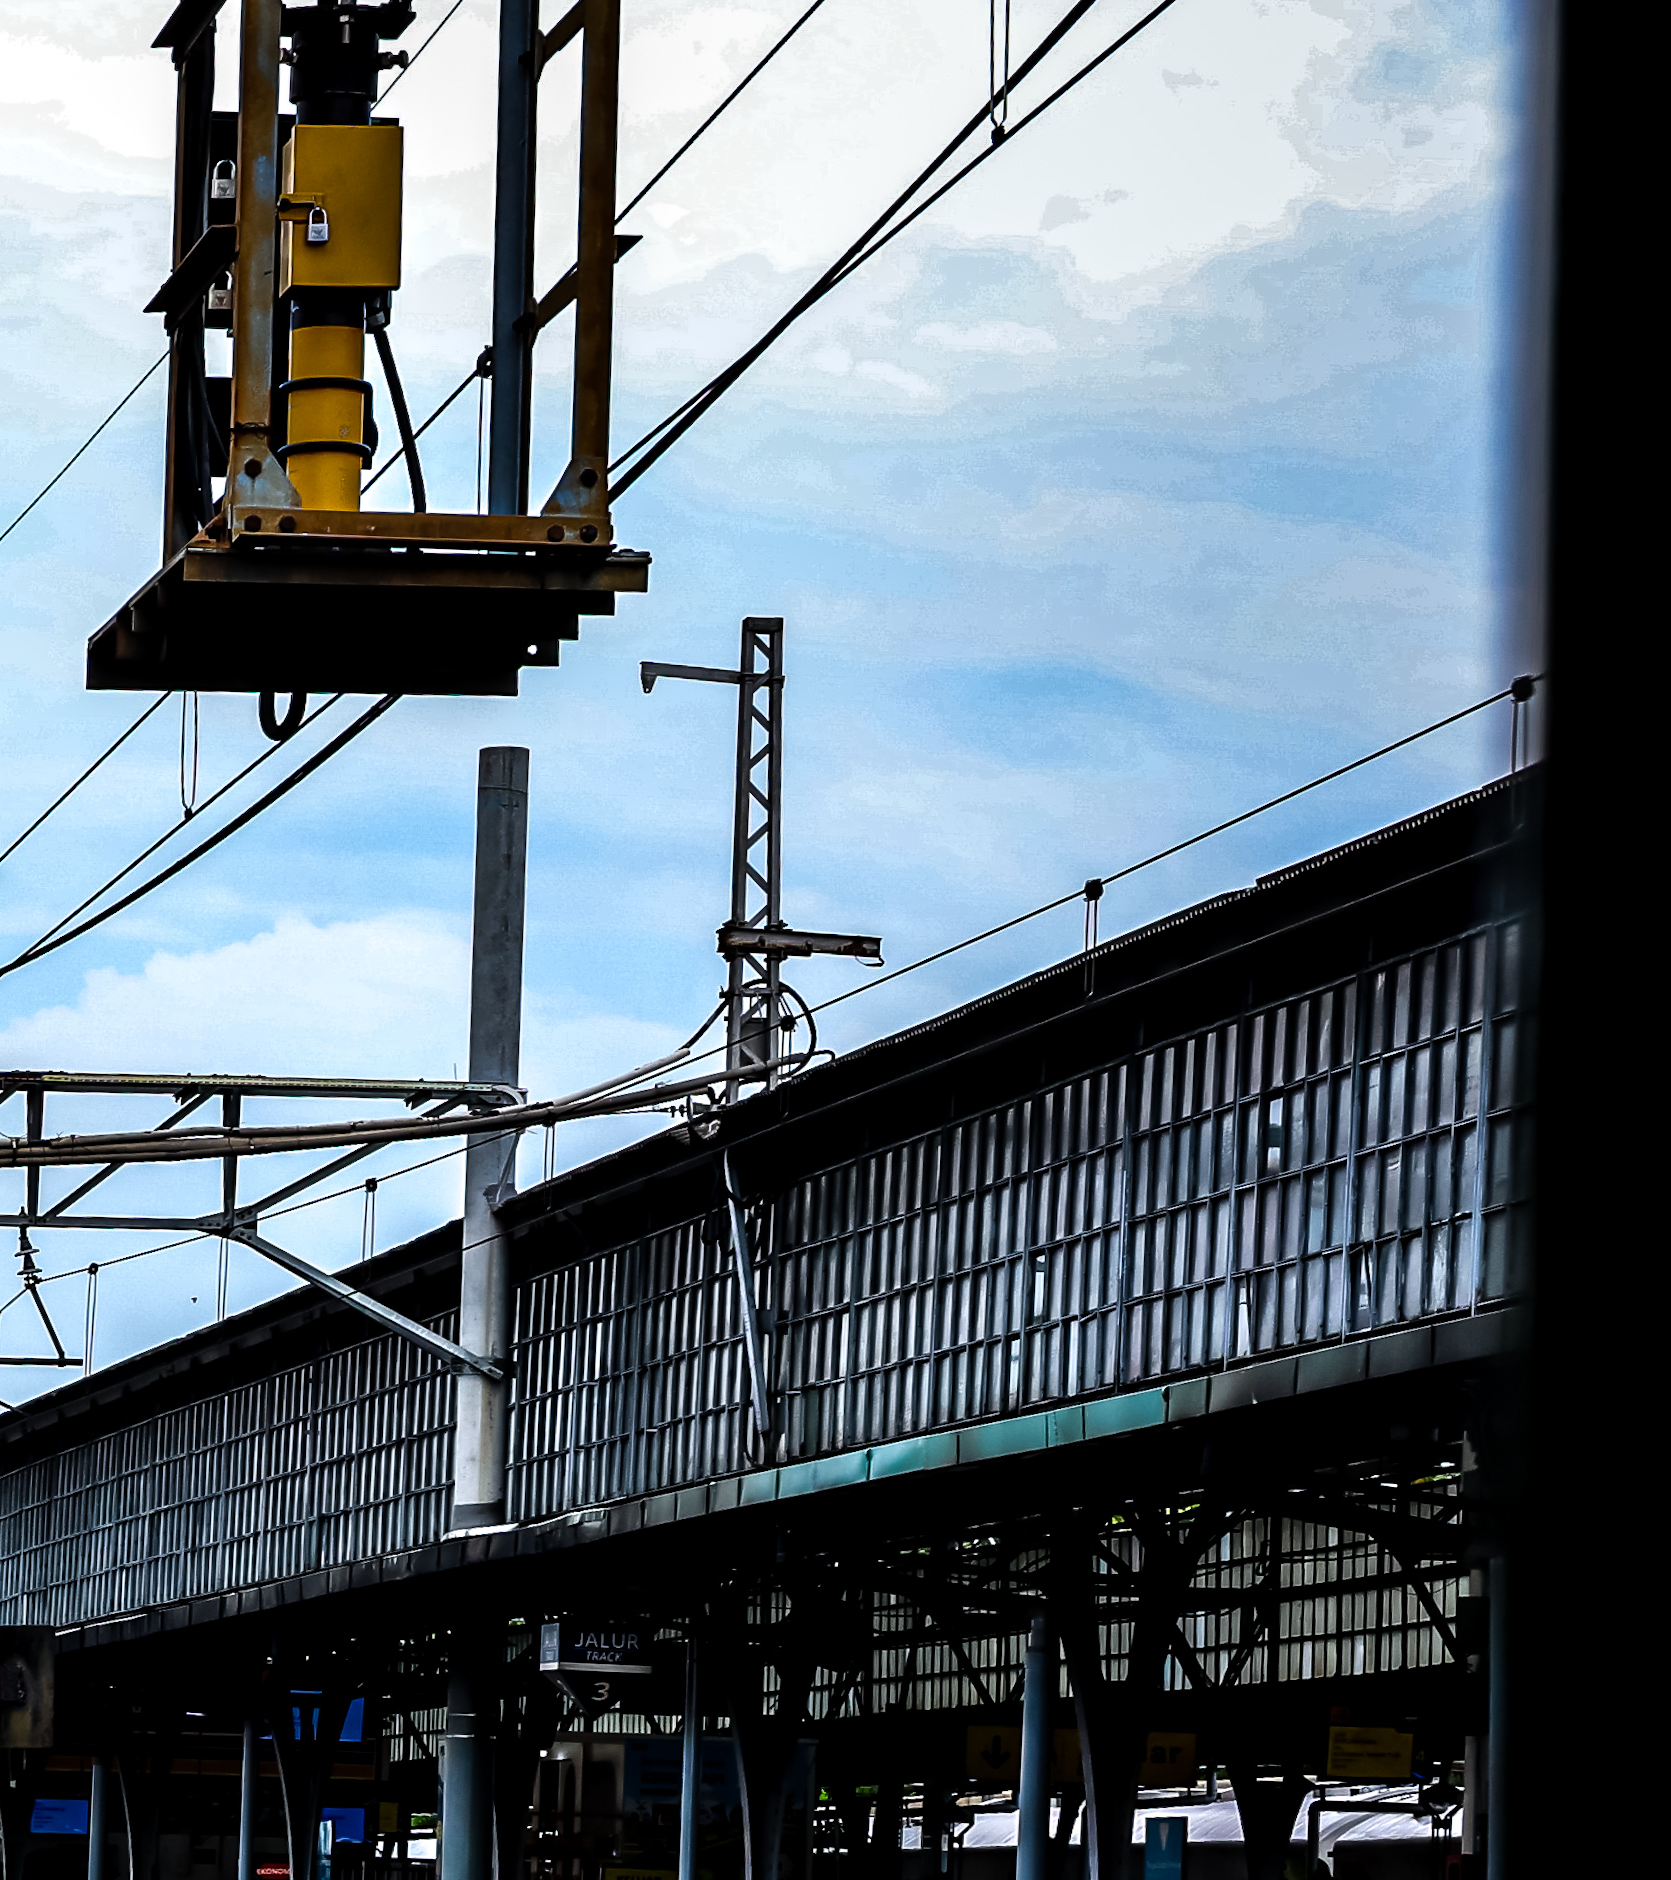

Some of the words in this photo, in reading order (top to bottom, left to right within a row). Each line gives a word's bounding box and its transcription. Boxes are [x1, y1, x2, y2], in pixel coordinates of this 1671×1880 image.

[574, 1632, 640, 1650] JALUR
[585, 1650, 623, 1662] TRACK
[590, 1681, 611, 1702] 3
